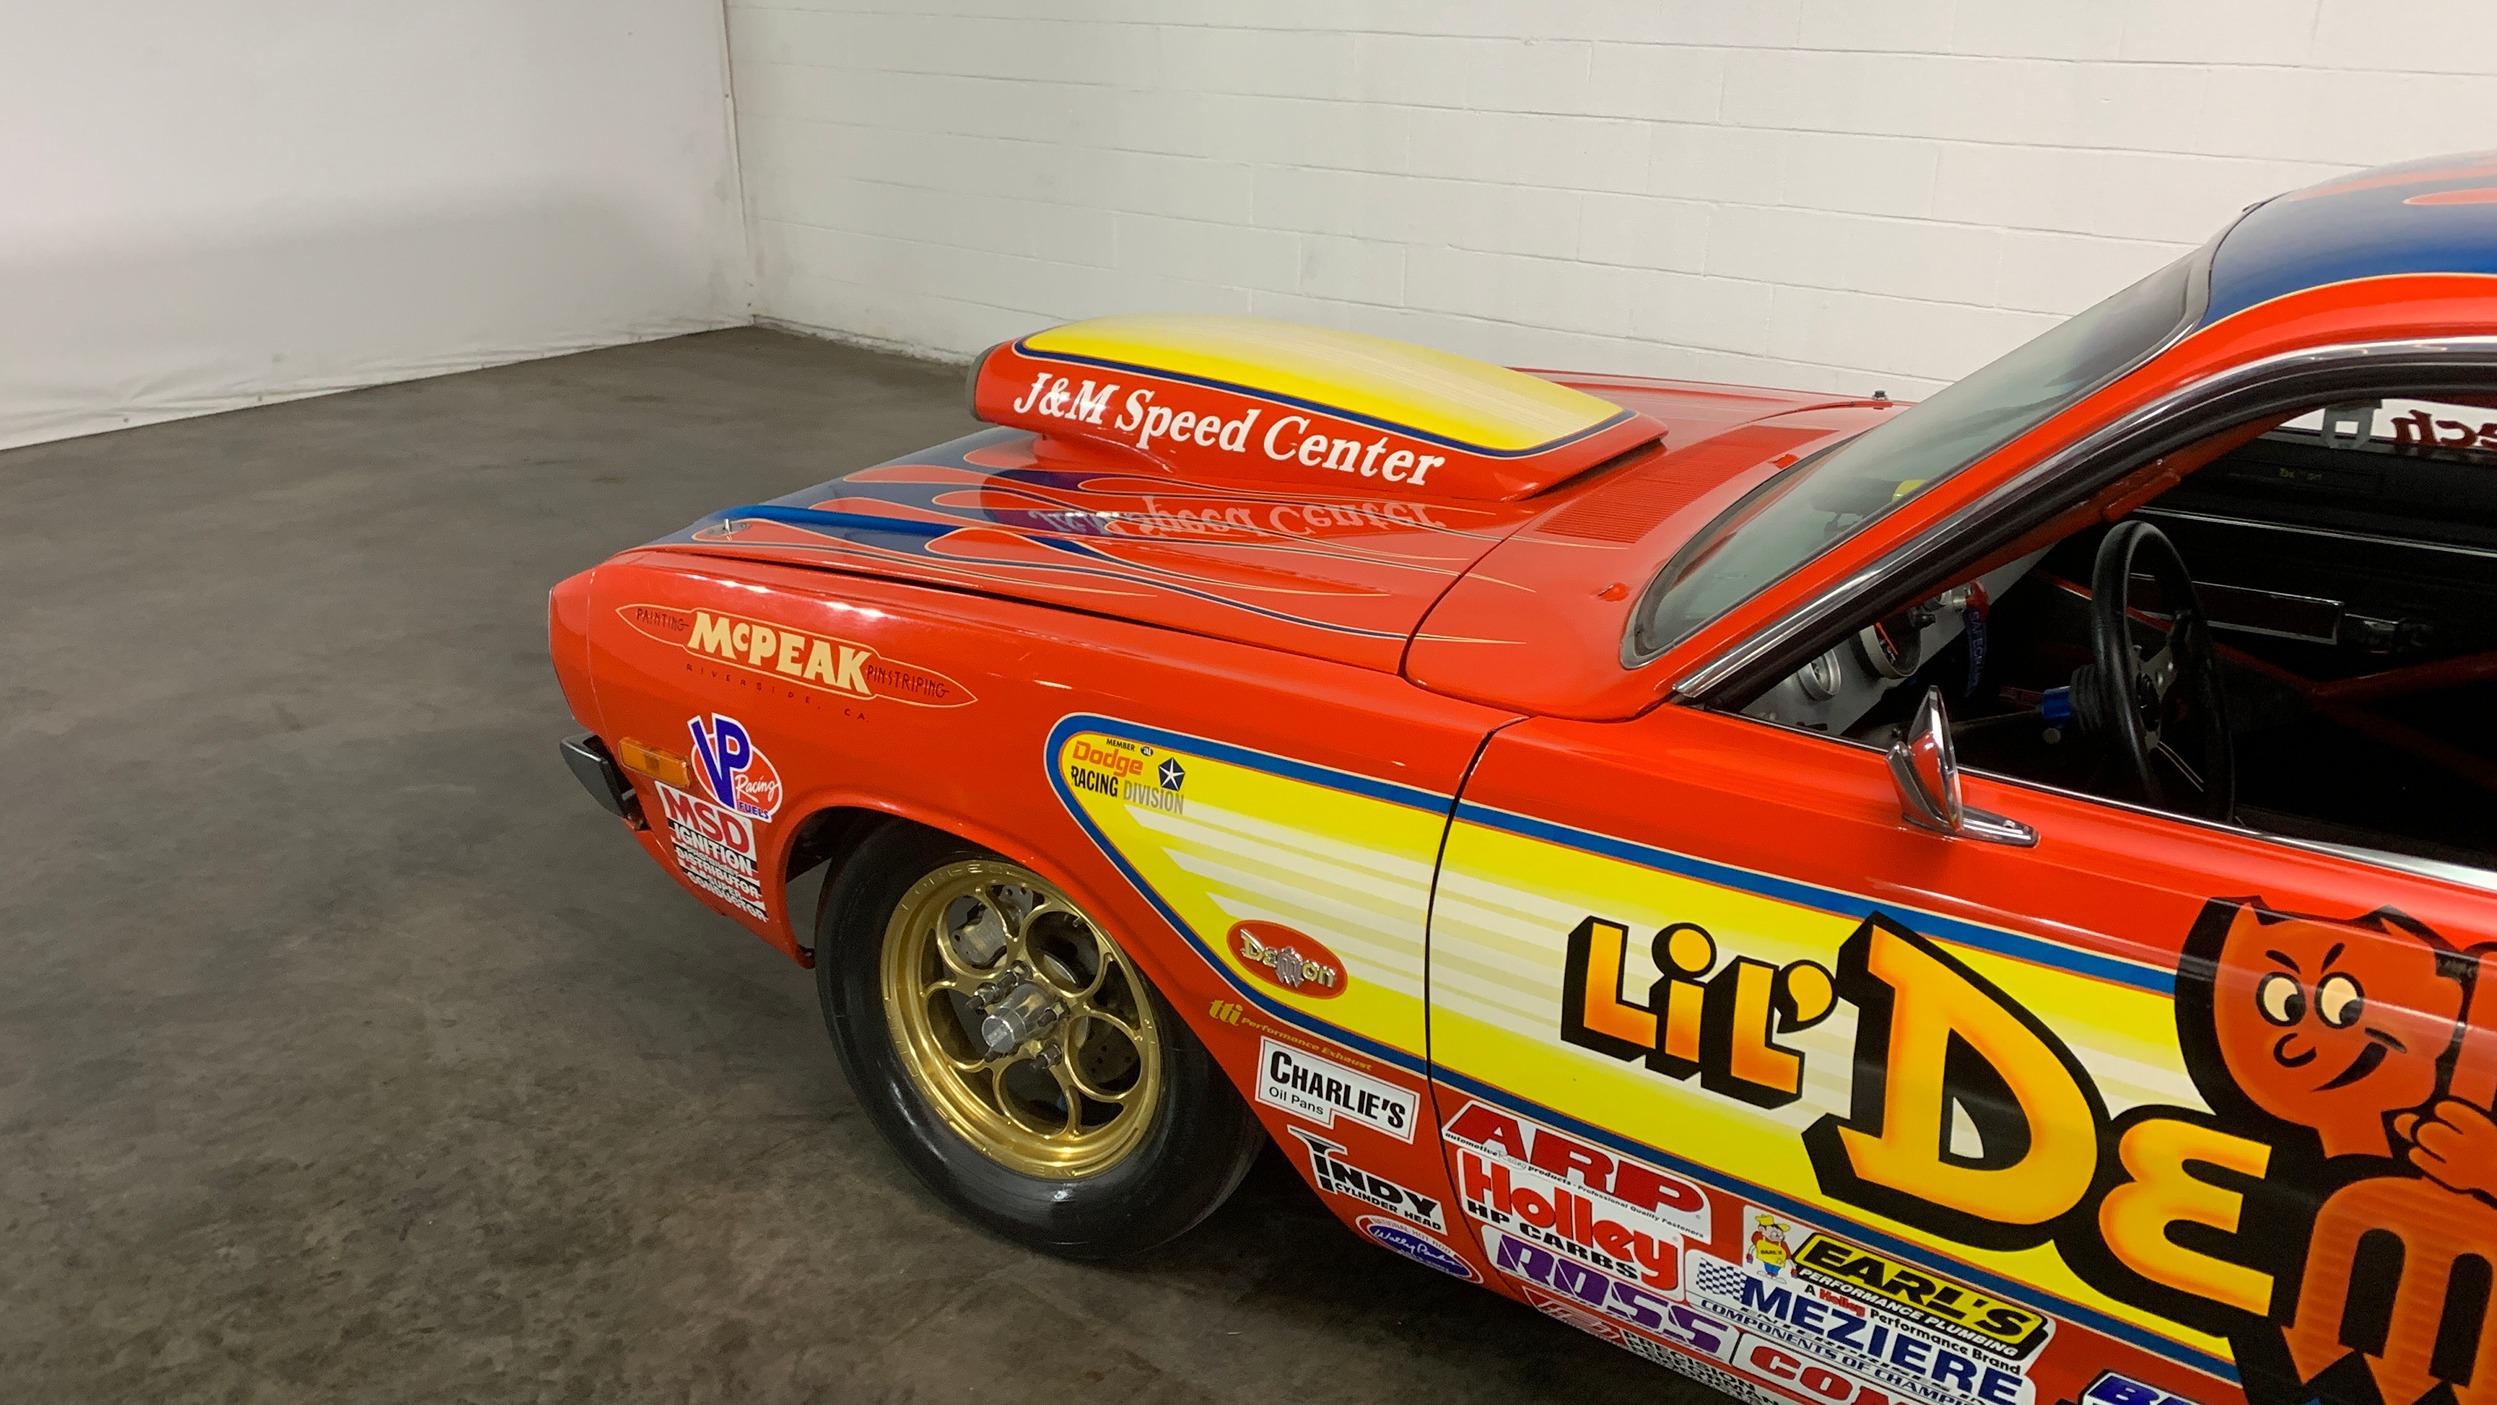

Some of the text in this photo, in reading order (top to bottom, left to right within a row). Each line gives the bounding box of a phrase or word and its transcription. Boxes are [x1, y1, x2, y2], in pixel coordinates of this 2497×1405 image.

[1013, 372, 1446, 486] J&M Speed Center
[636, 607, 690, 632] PAINTING
[687, 611, 873, 695] McPEAK
[866, 664, 950, 698] PINSTRIPING
[688, 714, 752, 811] VP
[1072, 740, 1144, 778] Dodge
[1106, 738, 1135, 752] MEMBER
[661, 786, 750, 854] MSD
[734, 773, 778, 802] Racing
[738, 801, 770, 819] FUELS
[1071, 765, 1185, 814] RACING DIVISION
[673, 821, 754, 877] IGNITION
[675, 846, 762, 899] DISTRIBUTOR
[1241, 1017, 1320, 1051] Performance
[1321, 1043, 1373, 1071] Exhaust
[1269, 1086, 1324, 1115] Oil Pans
[1270, 1050, 1406, 1129] CHARLIE'S
[1289, 1127, 1438, 1219] INDY
[1445, 1131, 1498, 1157] automotive
[1528, 1165, 1571, 1186] products
[1578, 1185, 1629, 1209] Professional
[1630, 1205, 1660, 1222] Quality
[1661, 1217, 1704, 1239] Fasteners
[1448, 1103, 1704, 1213] ARP
[1335, 1182, 1442, 1231] CYLINDER HEAD
[1412, 1229, 1429, 1243] HOT
[1432, 1240, 1452, 1255] ROD
[1463, 1151, 1679, 1292] Holley
[1467, 1199, 1639, 1281] HP CARBS
[1497, 1233, 1730, 1355] ROSS
[1799, 1268, 2019, 1358] PERFORMANCE PLUMBING
[1803, 1239, 2033, 1338] EARL'S
[1701, 1299, 1837, 1360] COMPONENTS
[1842, 1355, 1871, 1373] OF
[1741, 1277, 2024, 1405] MEZIERE
[1804, 1284, 2022, 1377] A Holley Performance Brand
